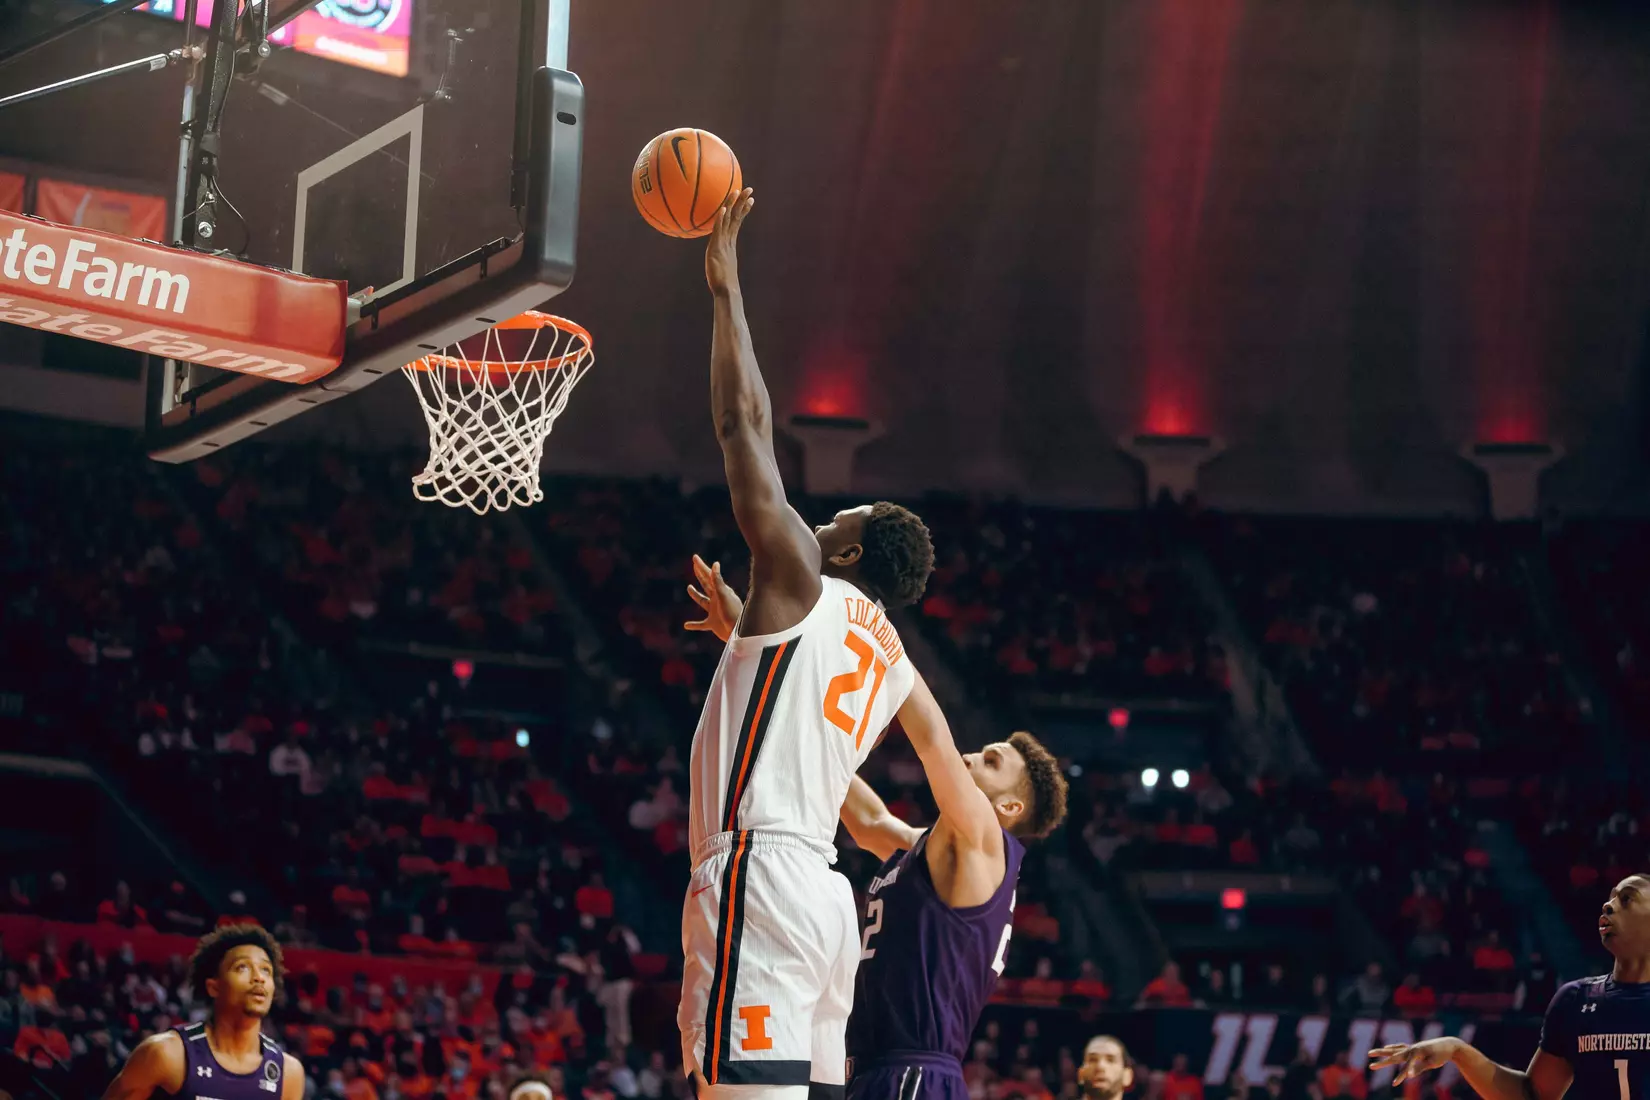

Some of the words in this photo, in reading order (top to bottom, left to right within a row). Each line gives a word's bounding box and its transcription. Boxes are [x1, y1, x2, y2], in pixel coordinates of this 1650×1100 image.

[845, 598, 903, 666] COCKBURN
[823, 629, 886, 752] 21
[1614, 1059, 1630, 1100] 1
